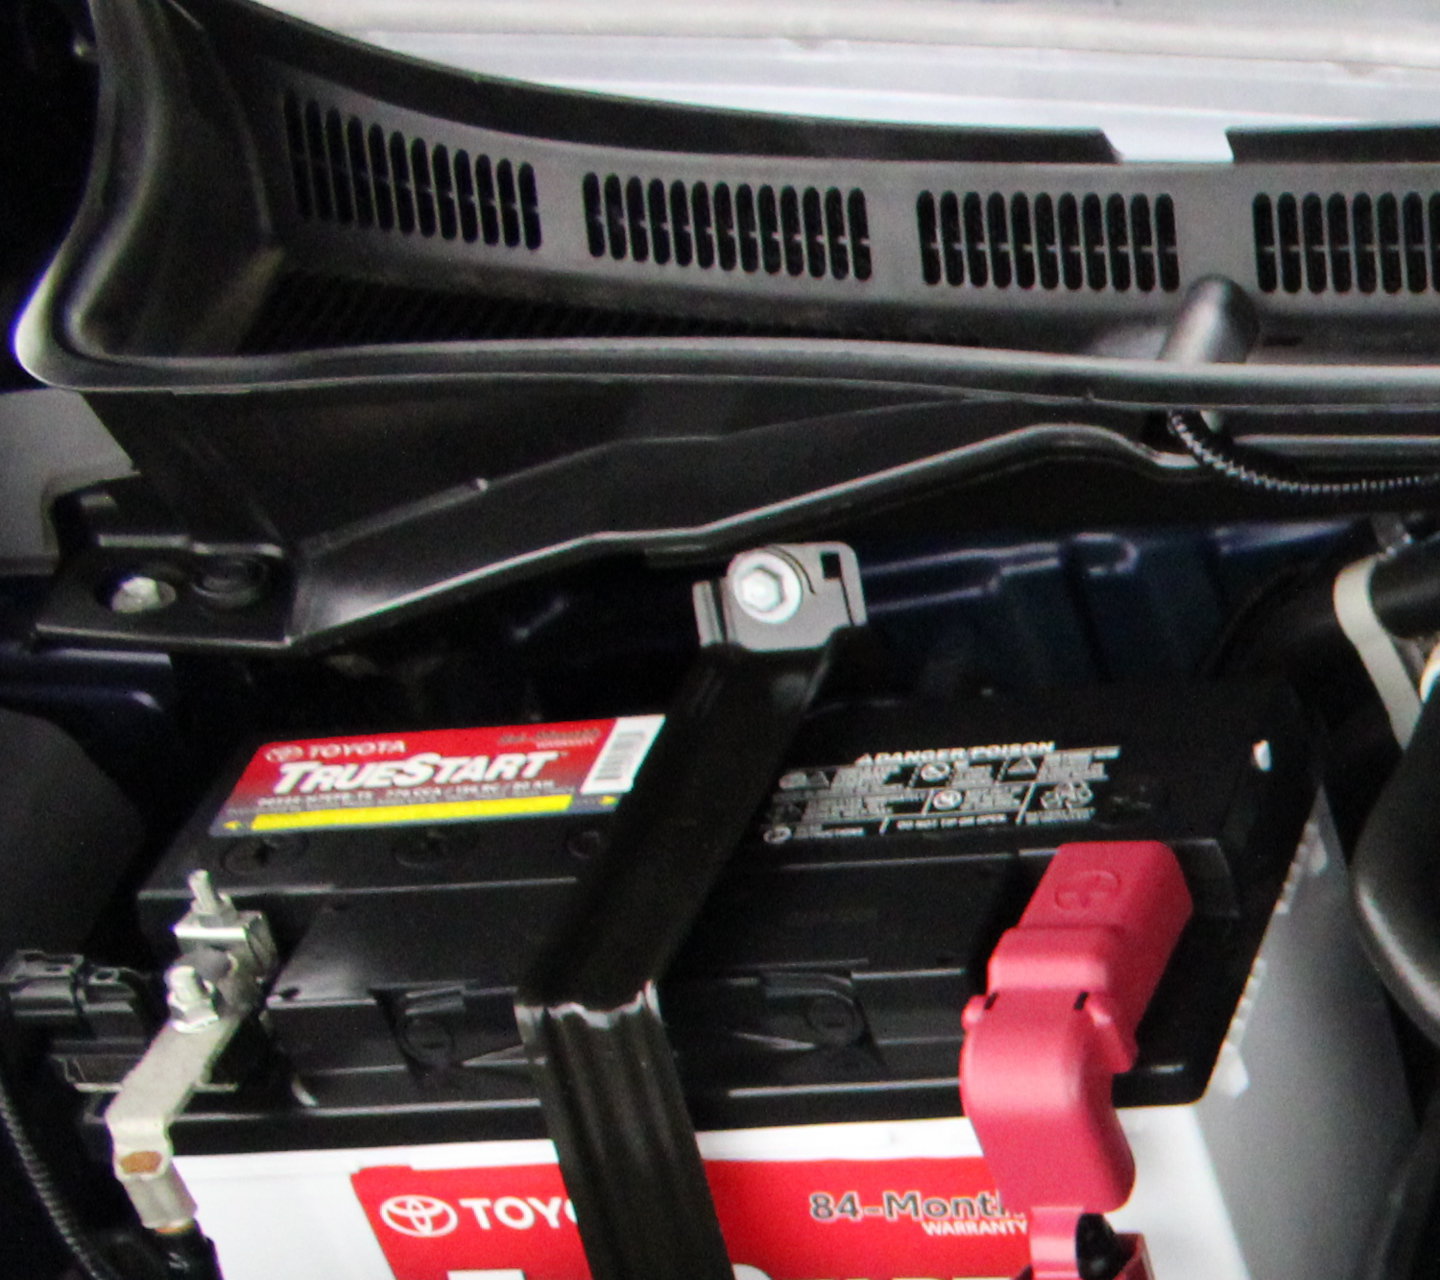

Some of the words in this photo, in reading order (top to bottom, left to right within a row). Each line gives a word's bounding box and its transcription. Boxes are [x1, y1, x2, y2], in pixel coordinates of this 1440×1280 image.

[308, 740, 406, 760] TOYOTA
[274, 752, 561, 795] TRUESTART
[921, 1220, 1028, 1236] WARRANTY
